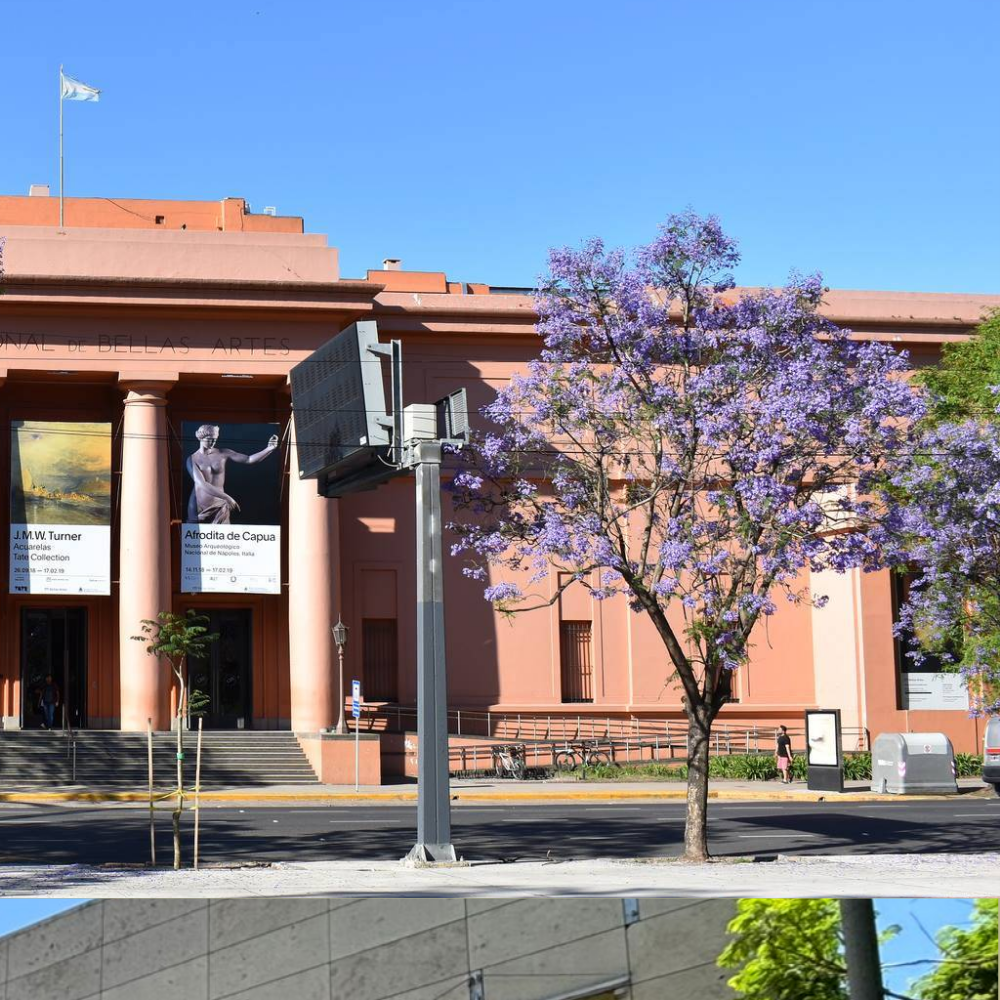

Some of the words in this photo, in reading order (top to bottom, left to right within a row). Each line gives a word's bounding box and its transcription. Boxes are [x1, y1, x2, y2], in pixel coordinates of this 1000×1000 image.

[67, 339, 87, 353] DE
[97, 334, 190, 355] BELLAS
[211, 336, 291, 357] ARTES
[13, 530, 47, 541] J.M.W.
[48, 531, 82, 541] Turner
[184, 530, 225, 540] Afrodita
[227, 531, 240, 541] de
[242, 531, 276, 543] Capua
[13, 543, 51, 551] Acuarelas
[30, 553, 70, 561] Collection
